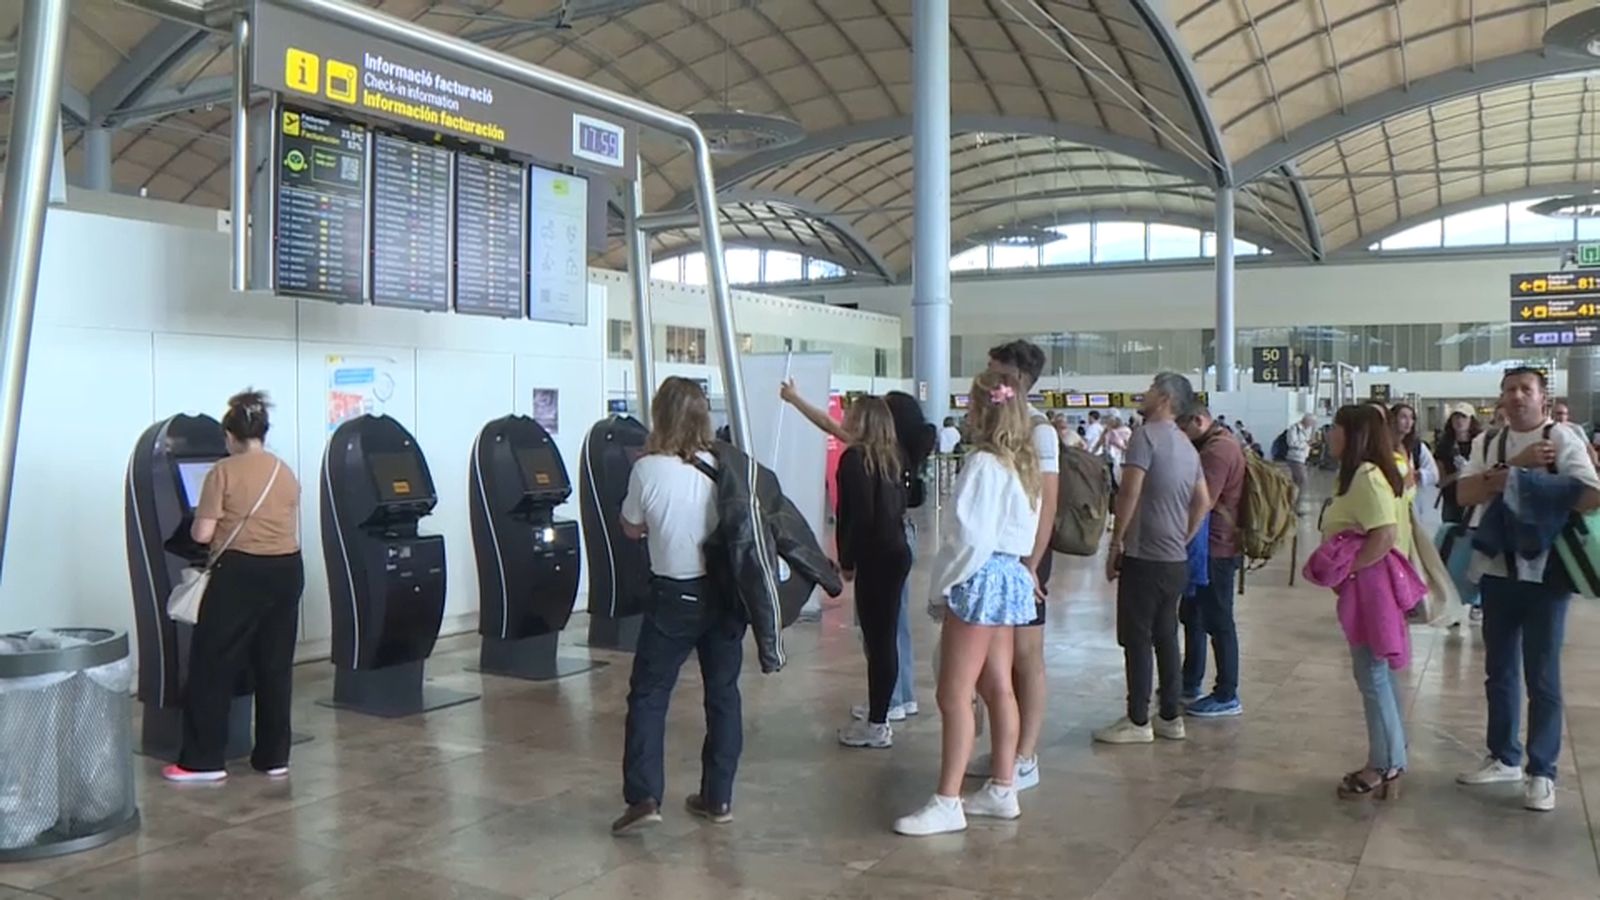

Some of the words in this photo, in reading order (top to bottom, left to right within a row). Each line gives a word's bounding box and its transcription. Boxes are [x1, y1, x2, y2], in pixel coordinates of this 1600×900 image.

[364, 52, 433, 86] Informació
[434, 72, 494, 105] facturació
[363, 73, 407, 97] Check-in
[407, 86, 460, 112] information
[363, 90, 438, 124] Información
[440, 111, 505, 142] facturación
[1578, 304, 1595, 316] 41
[1262, 348, 1280, 361] 50
[1262, 368, 1279, 381] 61
